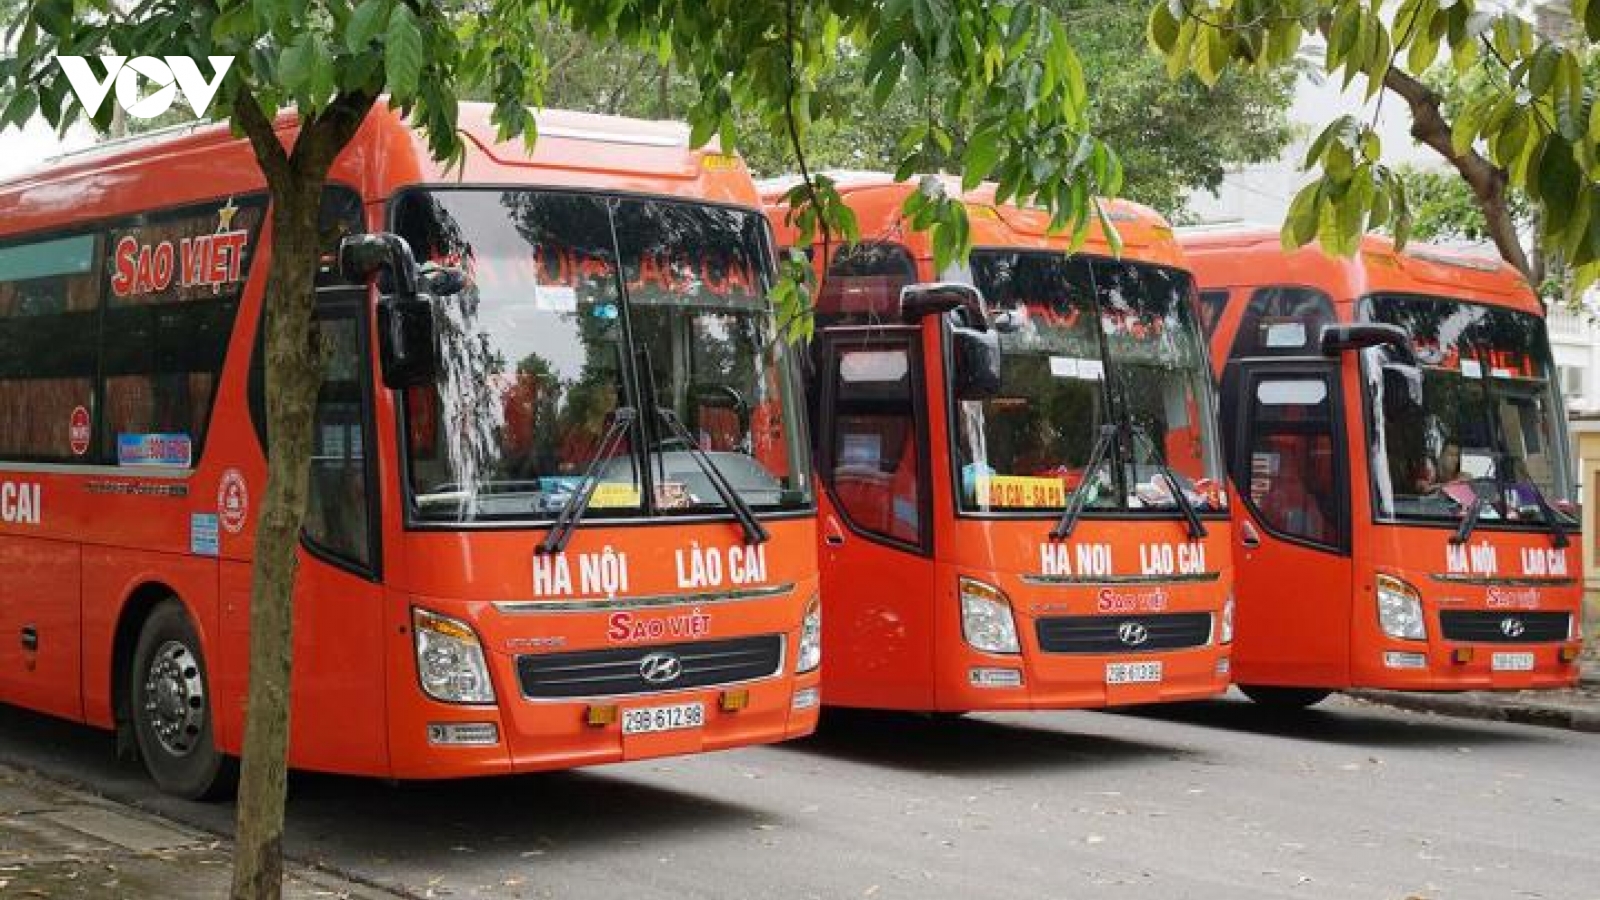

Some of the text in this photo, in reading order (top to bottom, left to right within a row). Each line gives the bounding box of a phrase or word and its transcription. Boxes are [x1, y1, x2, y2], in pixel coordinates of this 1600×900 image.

[111, 235, 174, 296] SAO
[1, 481, 41, 524] CAI
[578, 545, 628, 600] NỘI
[728, 545, 767, 584] CAI
[608, 611, 666, 642] SAO
